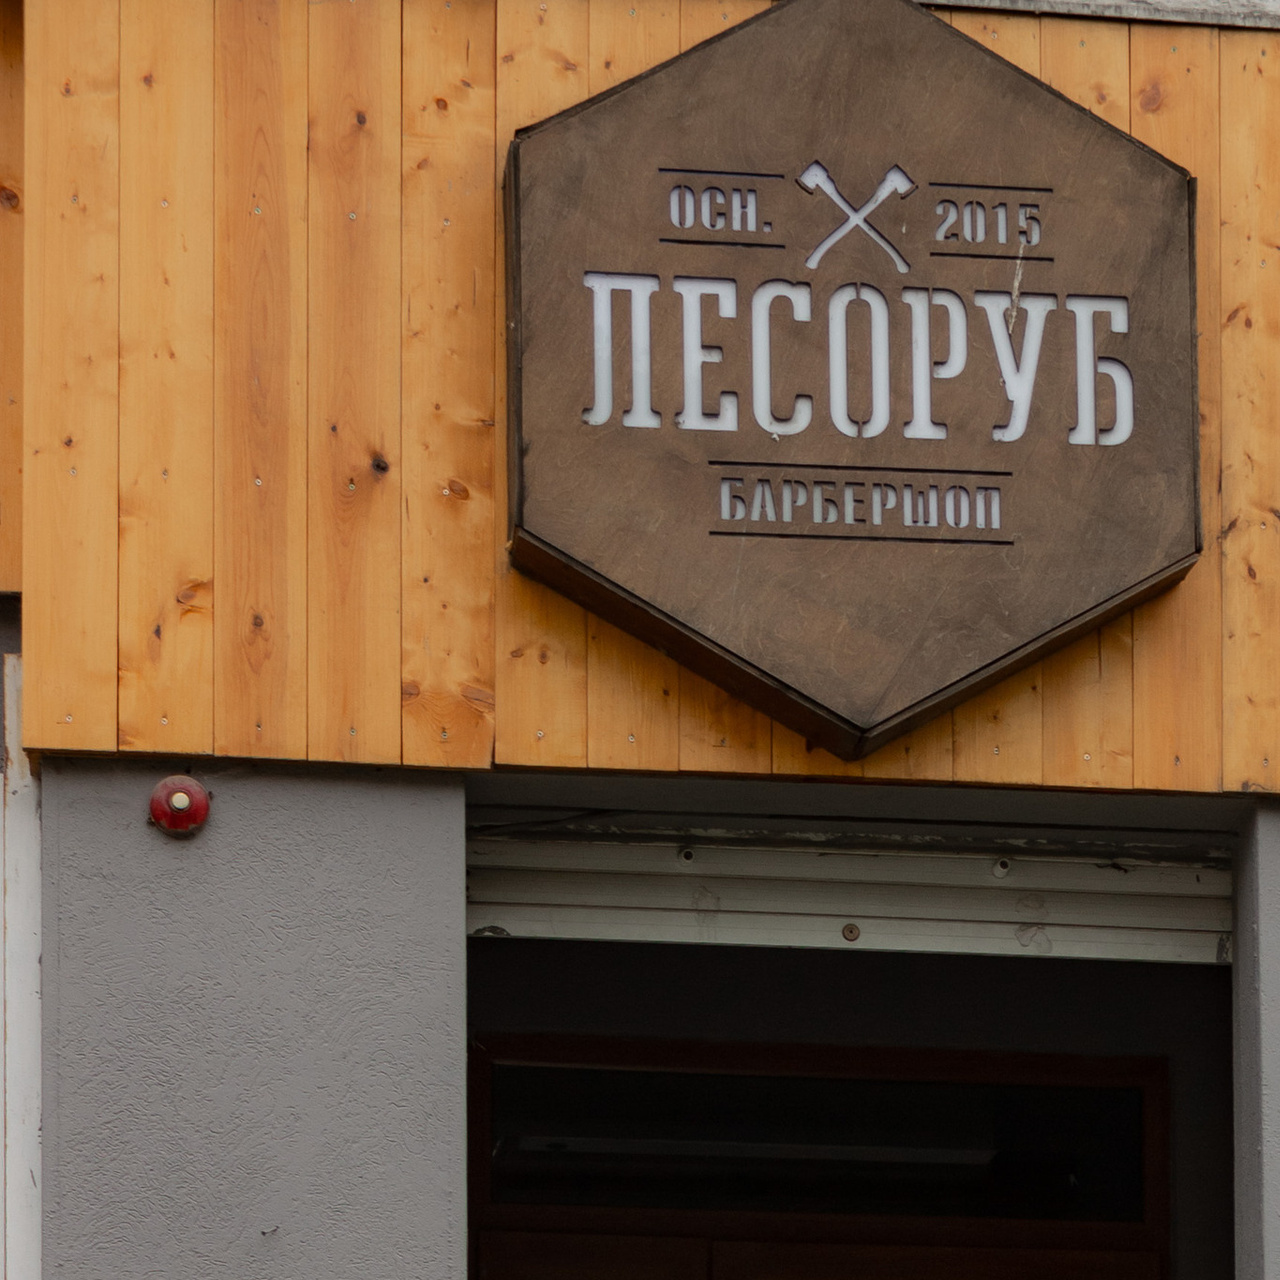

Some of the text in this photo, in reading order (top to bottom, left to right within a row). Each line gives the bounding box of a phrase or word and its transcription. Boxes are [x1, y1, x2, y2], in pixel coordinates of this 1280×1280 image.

[668, 184, 774, 234] ОСН.
[935, 199, 1042, 248] 2015
[581, 271, 1135, 447] ЛЕСОРУБ
[718, 476, 1002, 532] БАРБЕРШОП
